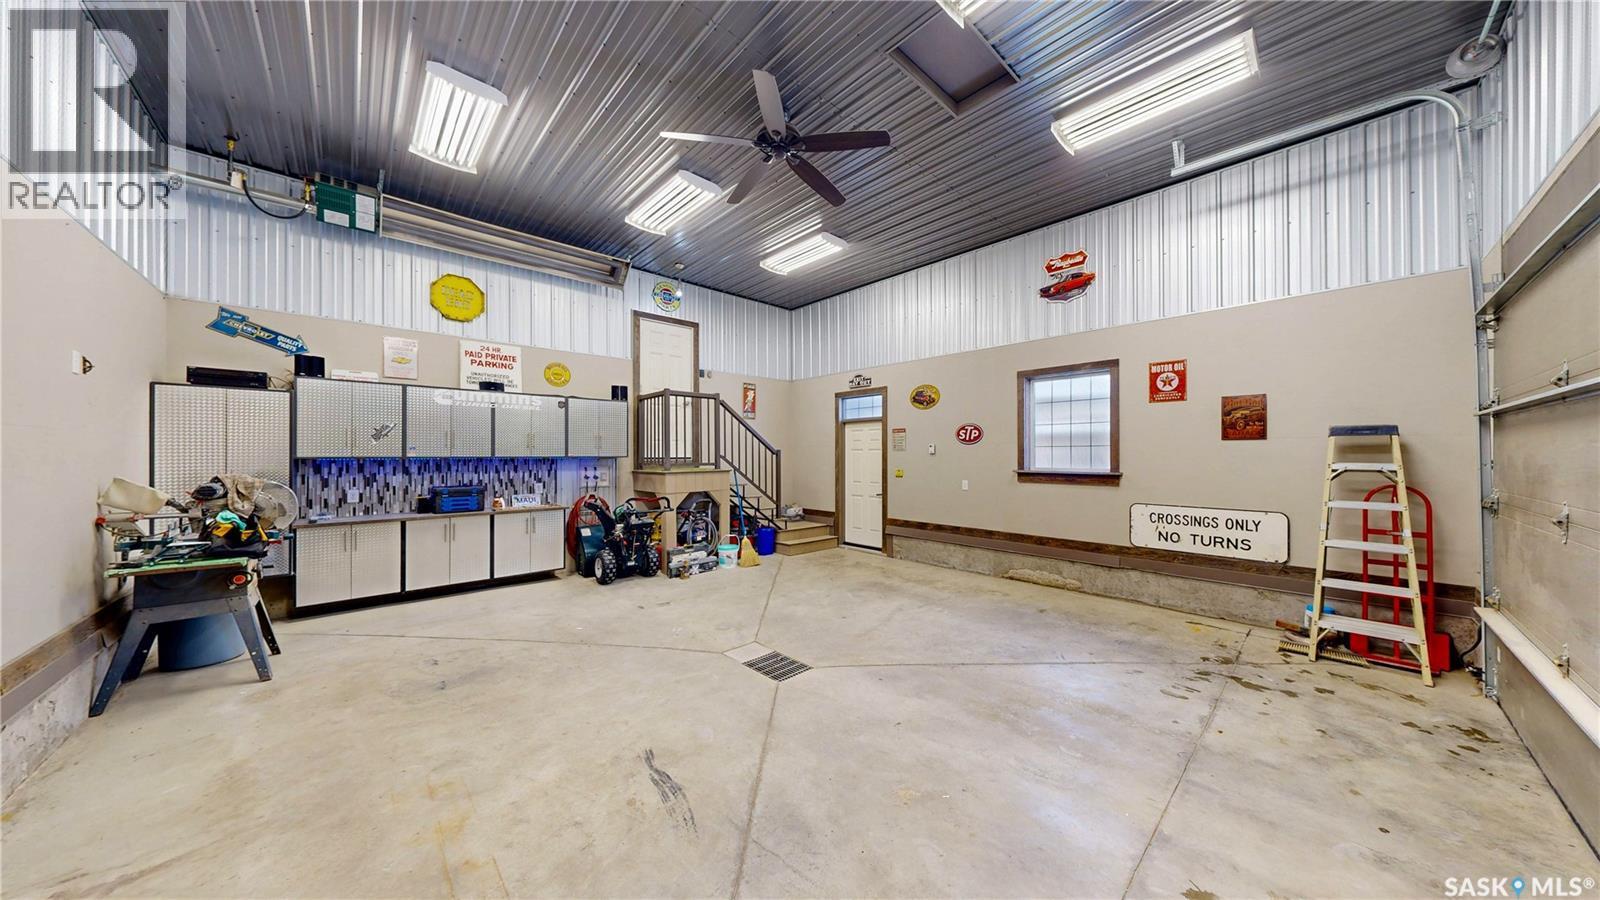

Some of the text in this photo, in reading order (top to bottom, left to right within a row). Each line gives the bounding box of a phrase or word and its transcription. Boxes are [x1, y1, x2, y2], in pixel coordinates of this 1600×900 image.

[277, 335, 303, 348] QUALITY
[277, 341, 297, 352] PARTS
[464, 350, 517, 363] PAID PRIVATE
[470, 360, 514, 370] PARKING
[1151, 362, 1184, 374] MOTOR OIL
[958, 426, 979, 441] STP
[1149, 512, 1261, 532] CROSSINGS ONLY
[1158, 531, 1252, 551] NO TURNS
